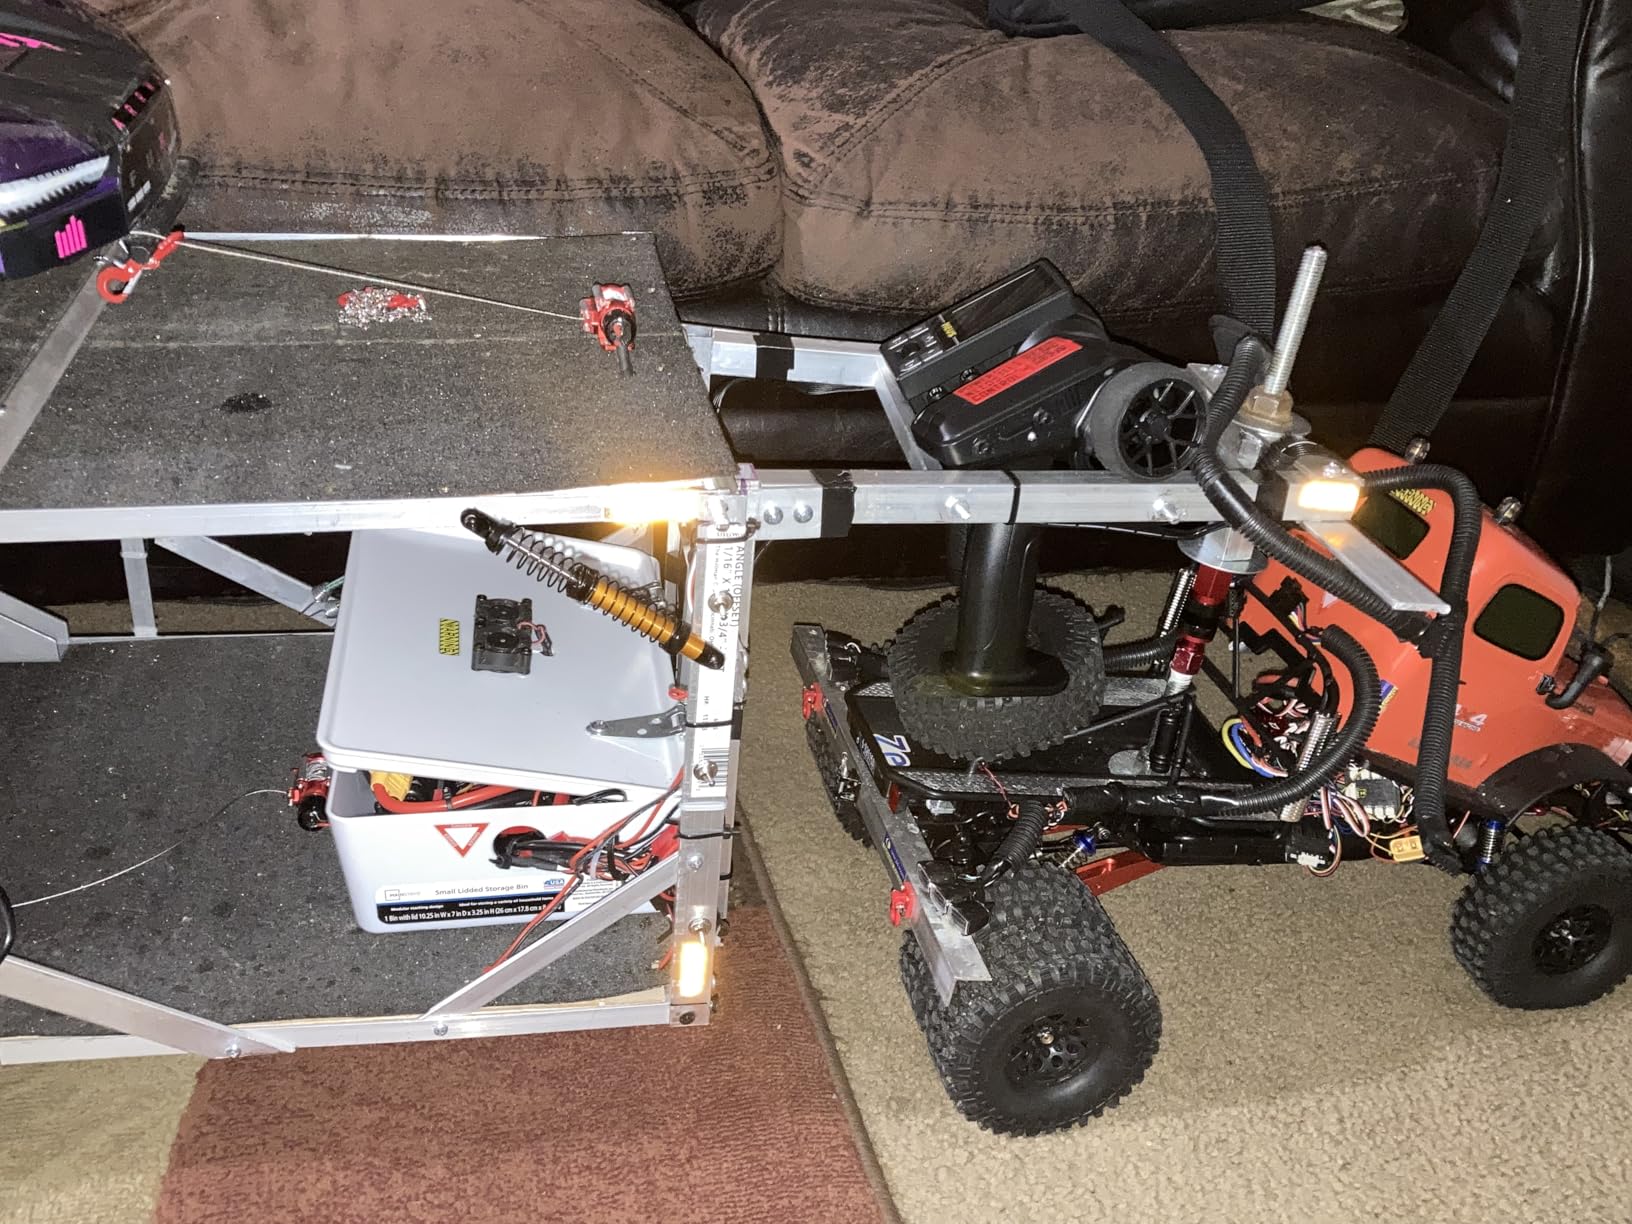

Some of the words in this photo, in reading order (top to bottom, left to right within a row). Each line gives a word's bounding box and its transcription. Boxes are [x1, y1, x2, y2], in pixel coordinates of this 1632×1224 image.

[734, 546, 745, 580] ANGLE
[435, 888, 456, 896] Small
[457, 886, 484, 894] Lidded
[485, 884, 514, 892] Storage
[399, 913, 411, 921] with
[419, 912, 434, 920] 10.25
[471, 908, 484, 916] 3.25
[495, 907, 505, 915] (26
